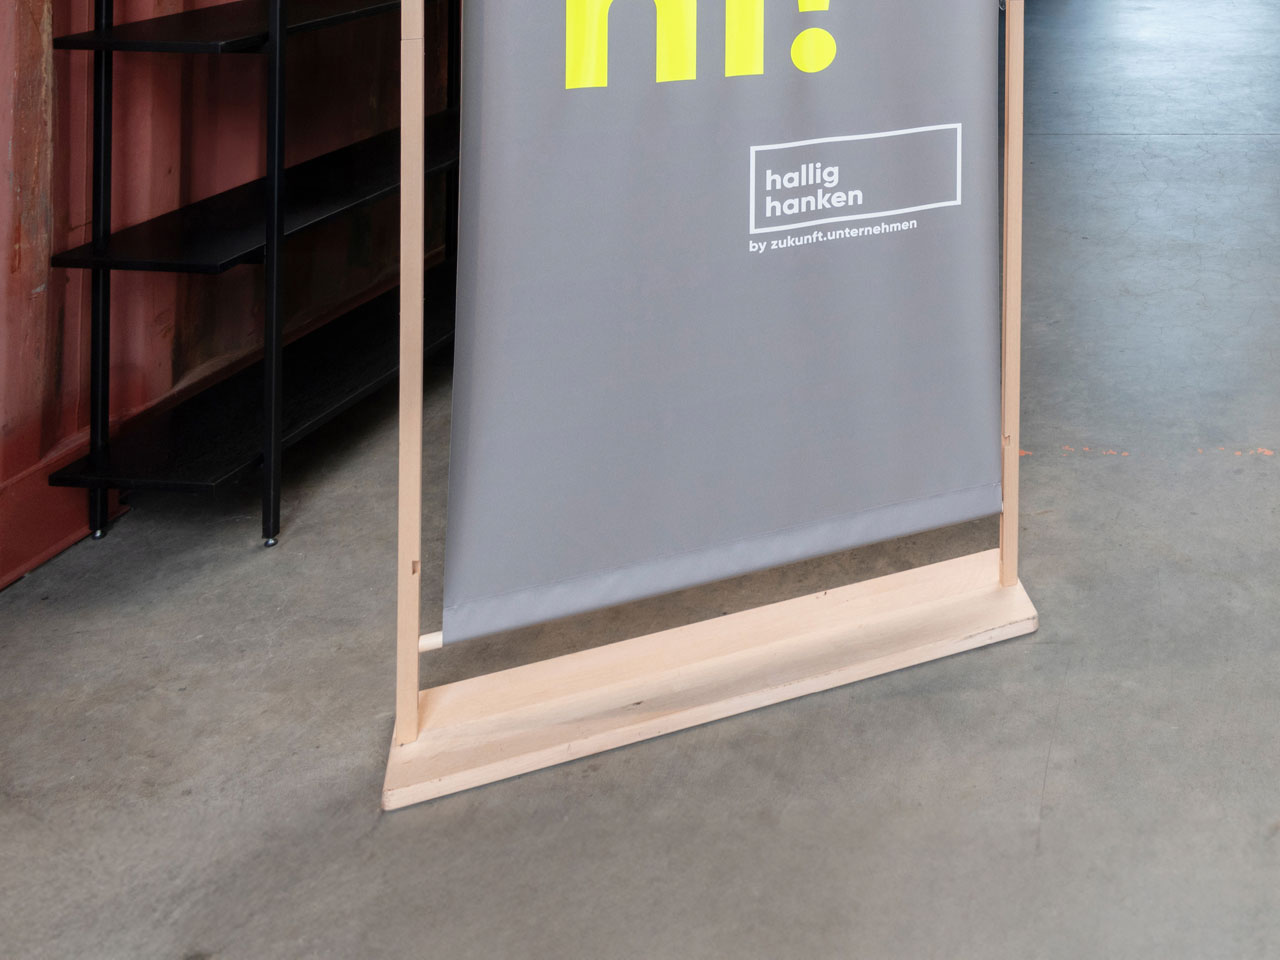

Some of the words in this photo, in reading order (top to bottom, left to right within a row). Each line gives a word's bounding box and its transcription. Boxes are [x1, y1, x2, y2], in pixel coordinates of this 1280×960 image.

[765, 162, 839, 188] hallig
[765, 189, 863, 218] hanken
[749, 240, 767, 253] by
[771, 220, 917, 249] zukunft.unternehmen
